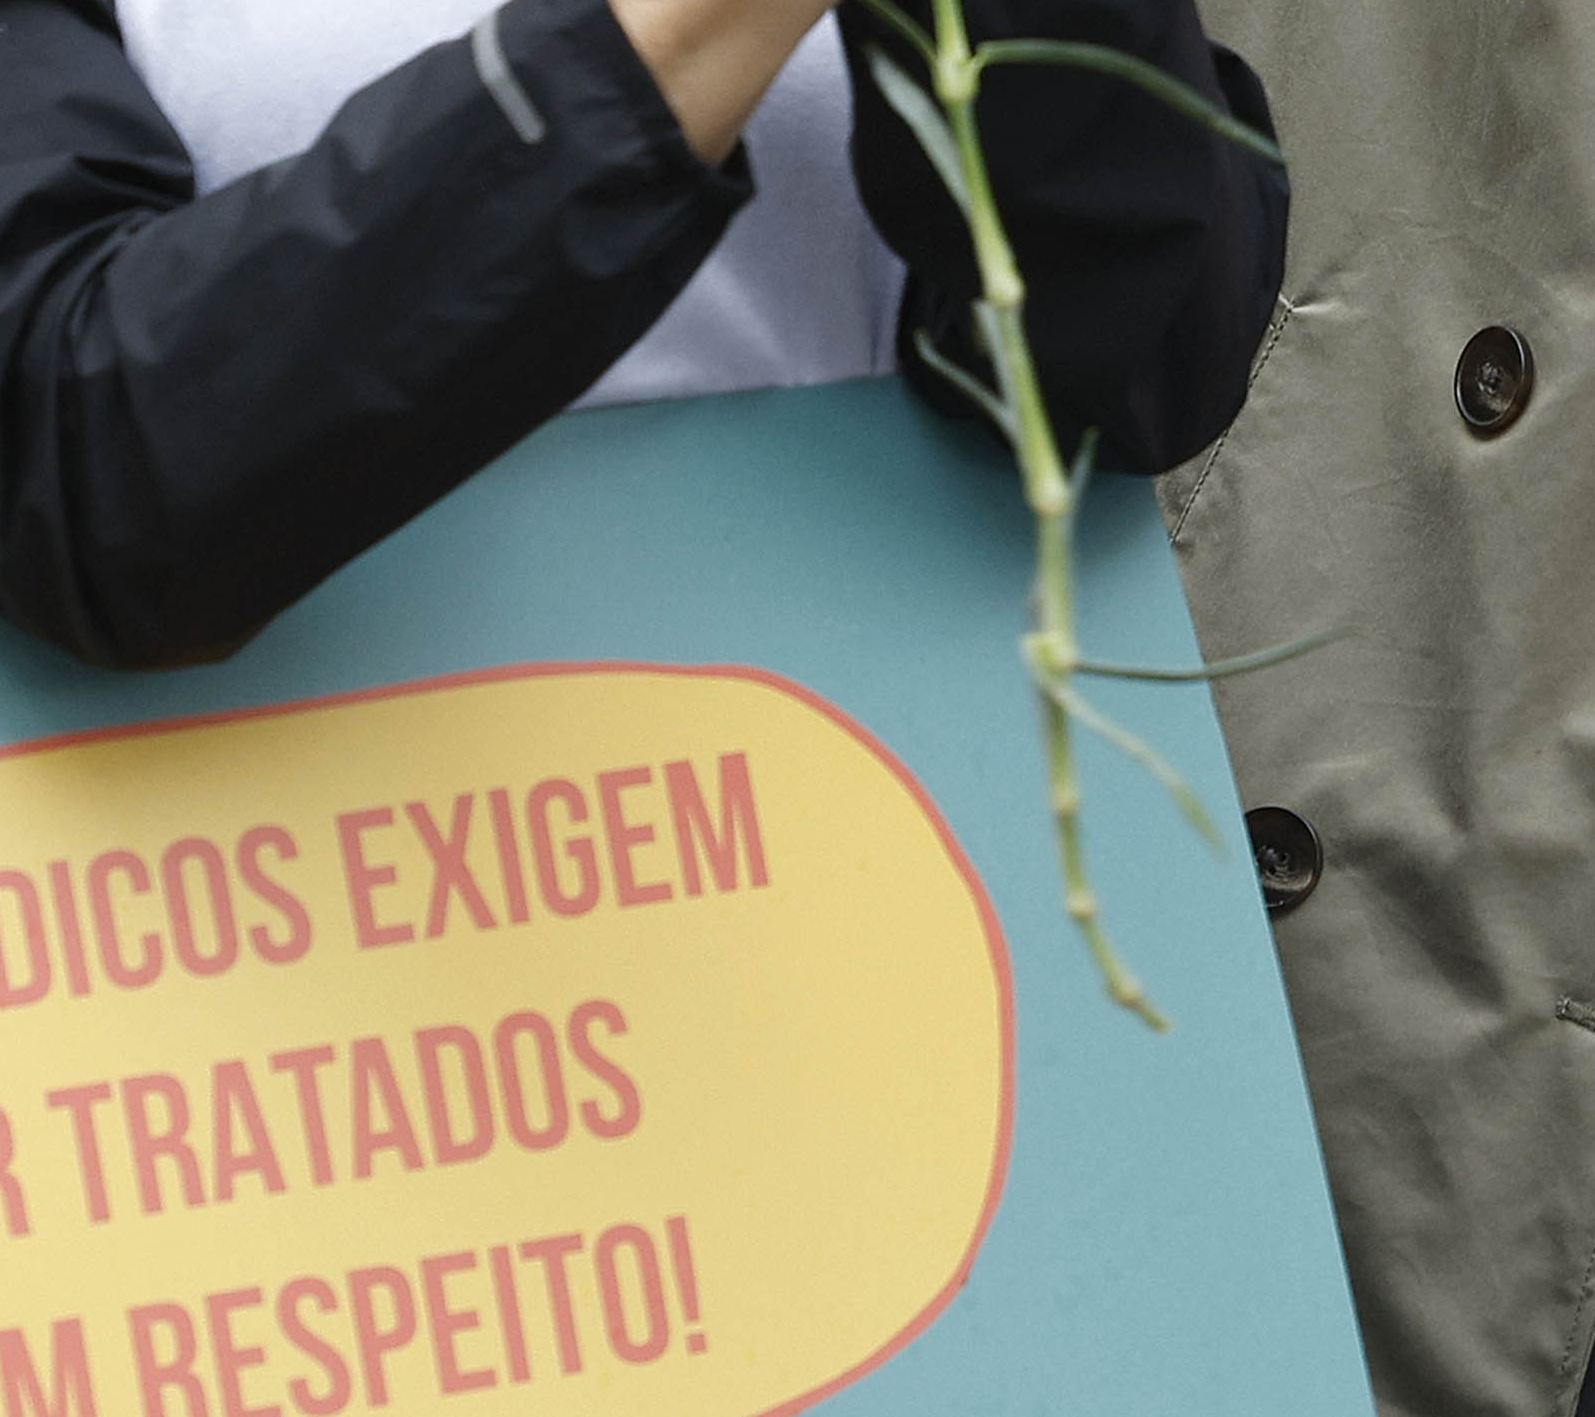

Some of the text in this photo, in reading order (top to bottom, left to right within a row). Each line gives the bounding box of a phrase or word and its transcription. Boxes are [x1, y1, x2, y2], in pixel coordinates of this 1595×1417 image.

[333, 751, 772, 953] EXIGEM
[47, 998, 644, 1225] TRATADOS
[126, 1214, 709, 1417] RESPEITO!
